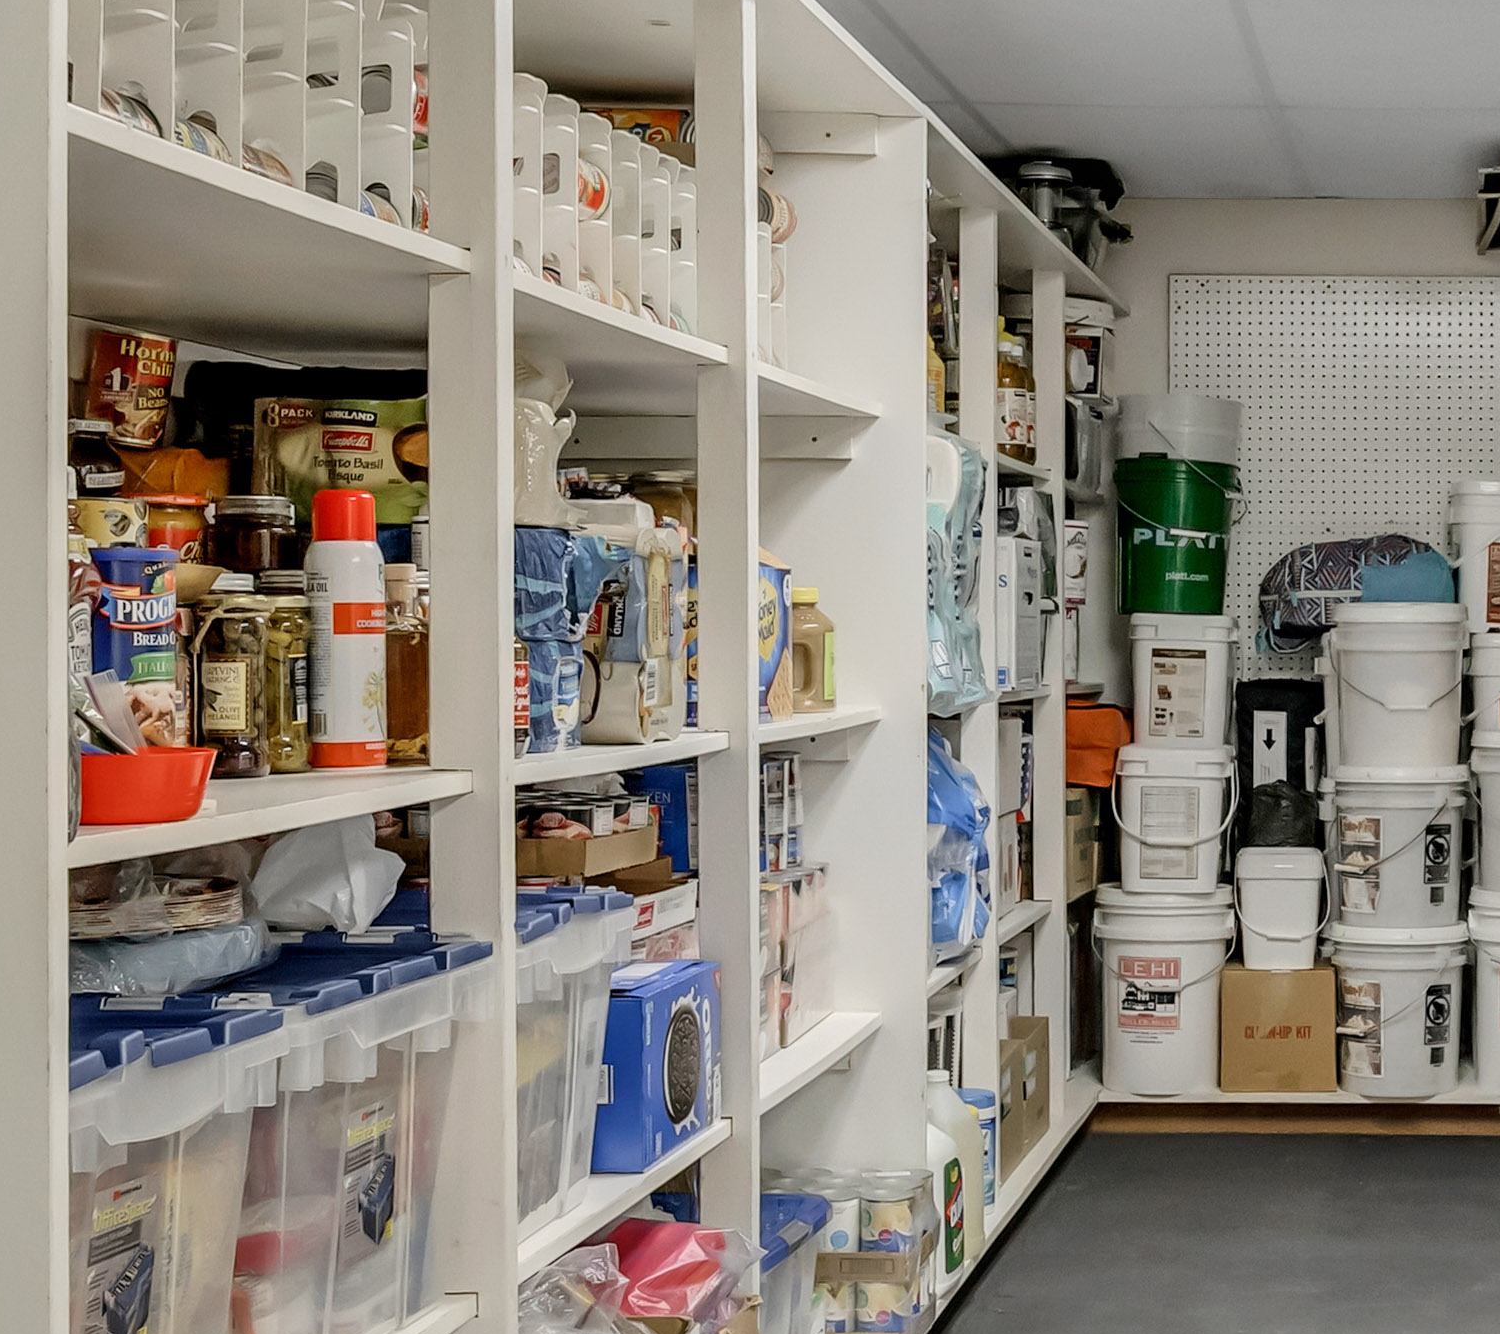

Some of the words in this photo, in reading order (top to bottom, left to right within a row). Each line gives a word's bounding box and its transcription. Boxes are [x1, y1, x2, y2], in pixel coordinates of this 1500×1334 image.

[120, 338, 175, 363] Horm
[137, 359, 173, 378] Chili
[147, 387, 165, 399] NO
[280, 407, 313, 418] PACK
[324, 409, 375, 422] KIRKLAND
[312, 456, 351, 469] Tomato
[353, 457, 384, 469] Basil
[132, 631, 169, 647] BREAD
[1120, 959, 1175, 977] LEHI
[1295, 1025, 1312, 1040] KIT
